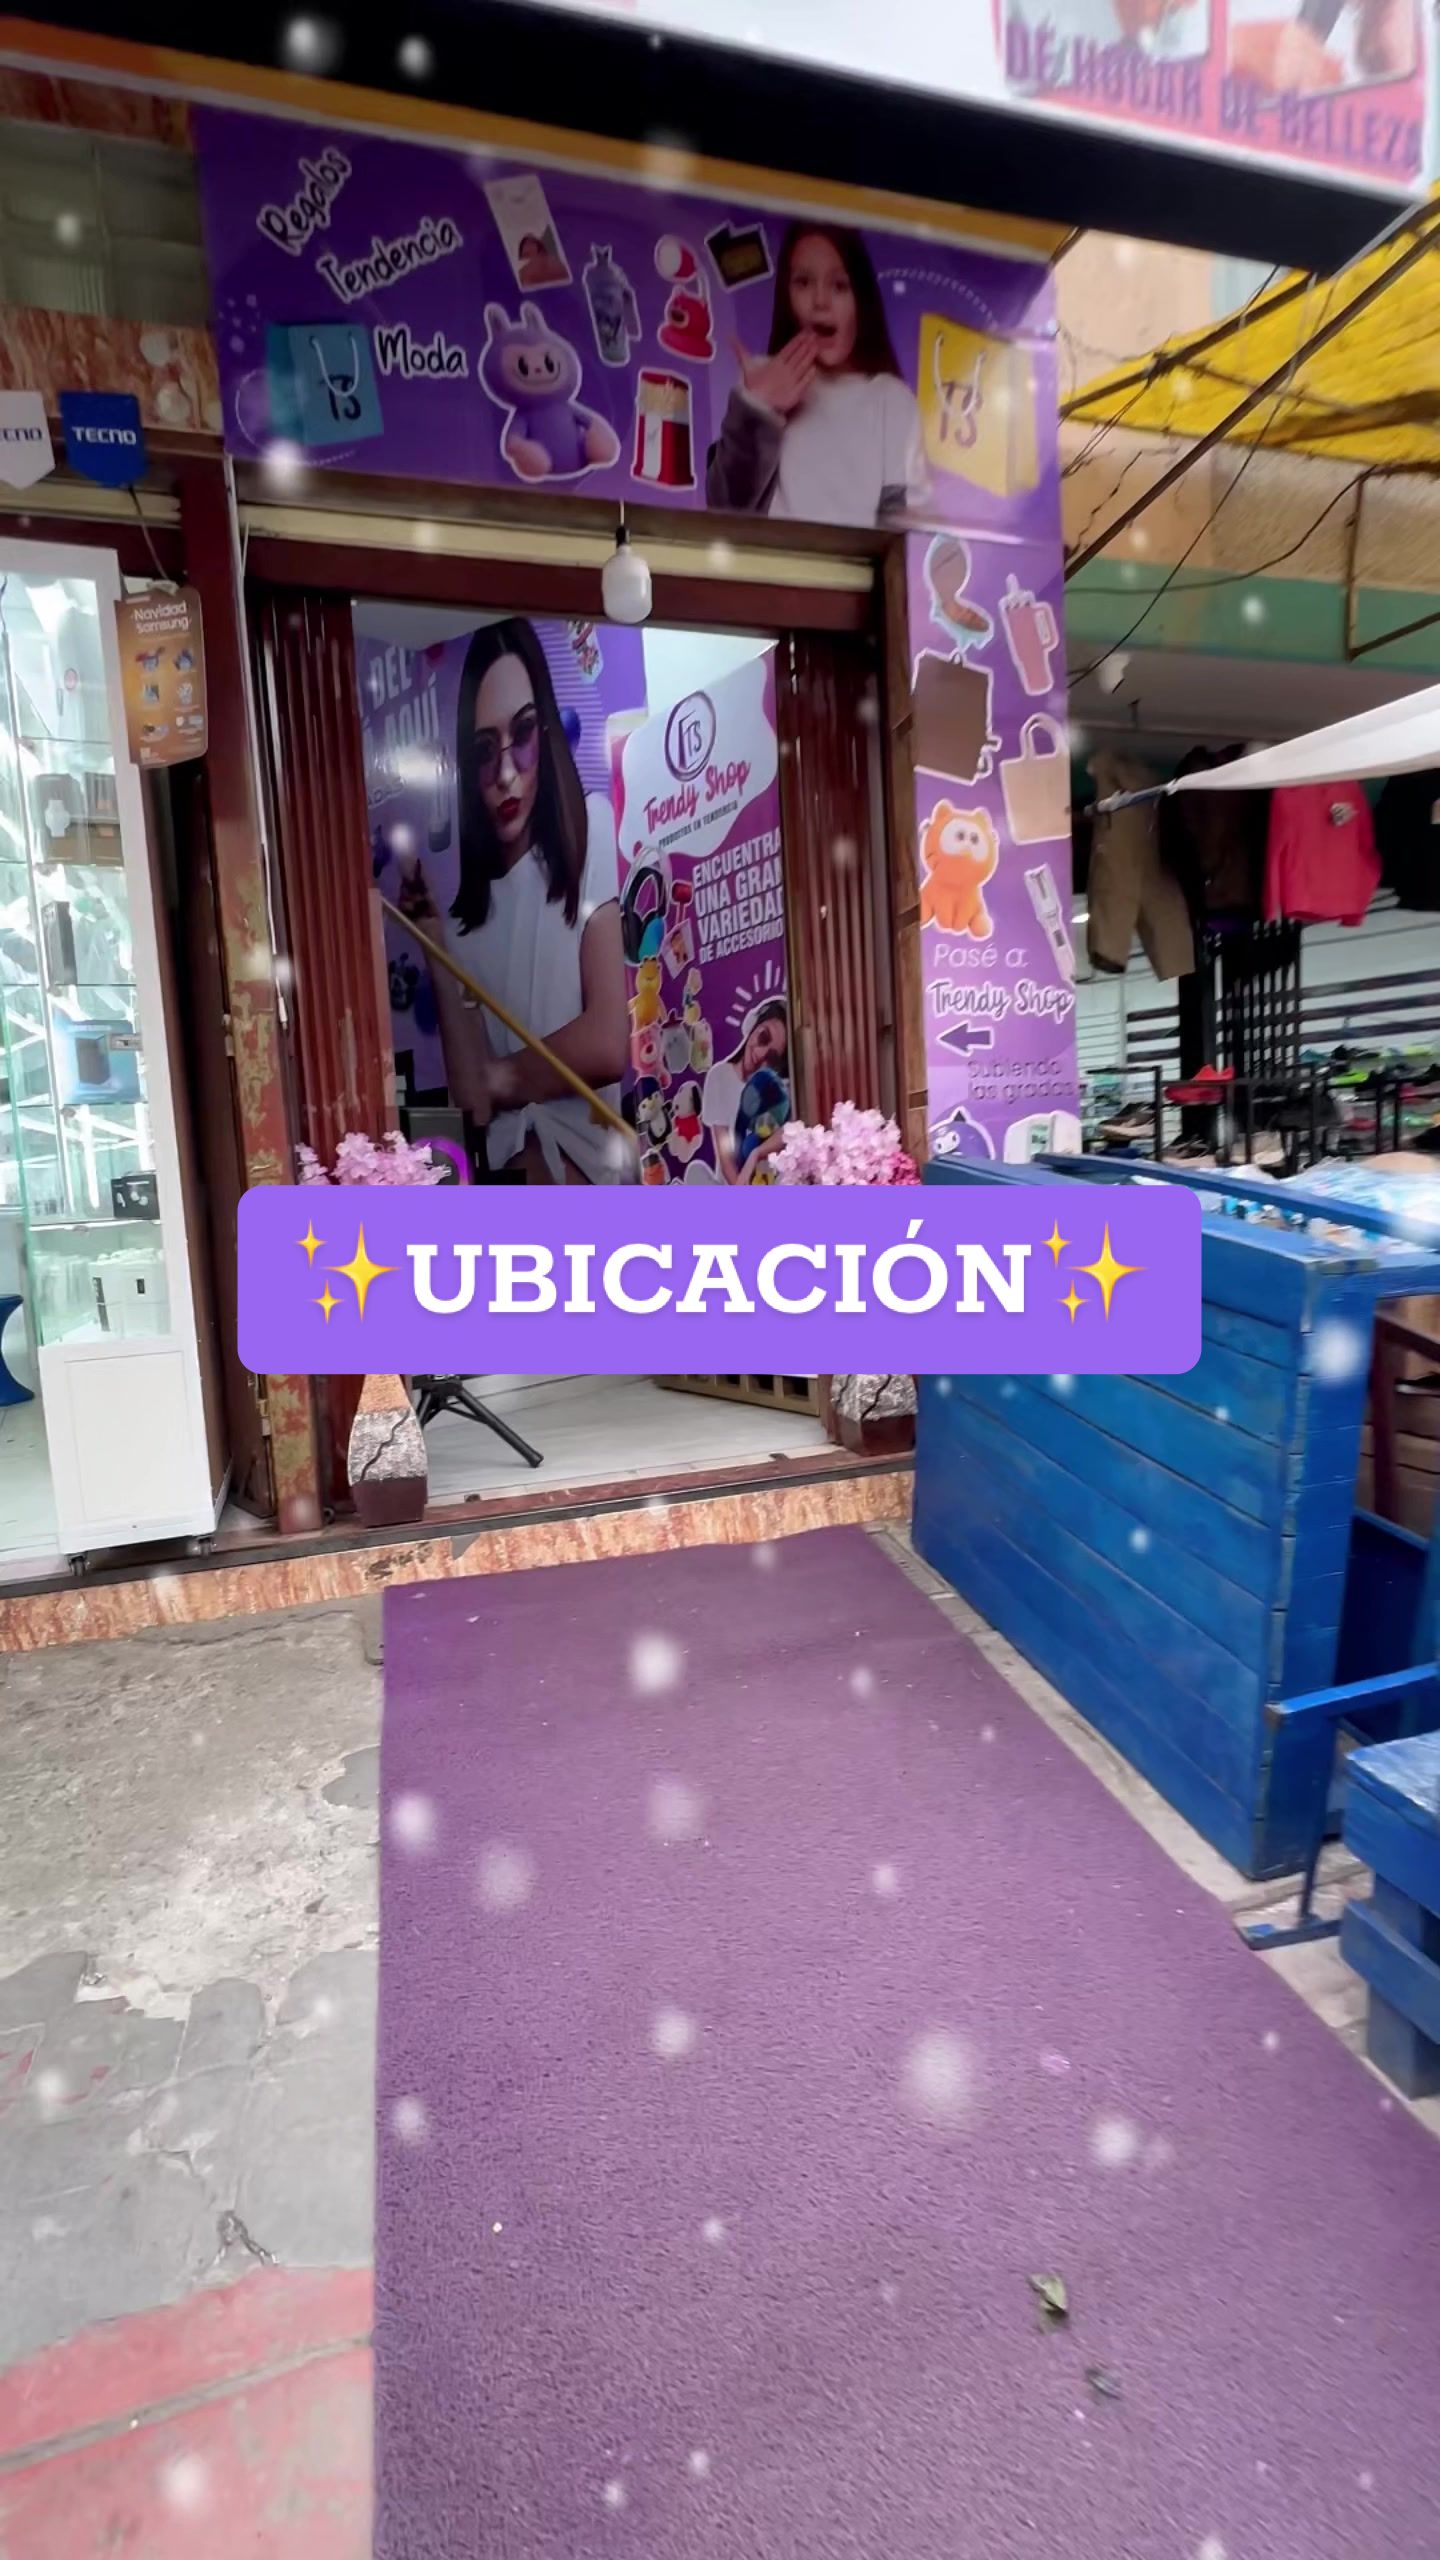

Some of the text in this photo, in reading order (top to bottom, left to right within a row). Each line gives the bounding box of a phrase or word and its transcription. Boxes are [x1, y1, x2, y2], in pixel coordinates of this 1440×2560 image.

[260, 149, 350, 252] Regalos
[319, 217, 460, 301] Tendencia
[376, 326, 466, 377] Moda
[72, 426, 137, 445] TECNO
[134, 601, 187, 622] Navidad
[136, 616, 190, 635] Samsung
[643, 761, 751, 834] Trendy Shop
[695, 880, 732, 918] UNA
[700, 944, 715, 965] DE
[934, 943, 997, 968] Pasé
[929, 979, 1075, 1022] Trendy Shop
[967, 1056, 1063, 1078] Subiendo
[1003, 1078, 1075, 1105] gradas
